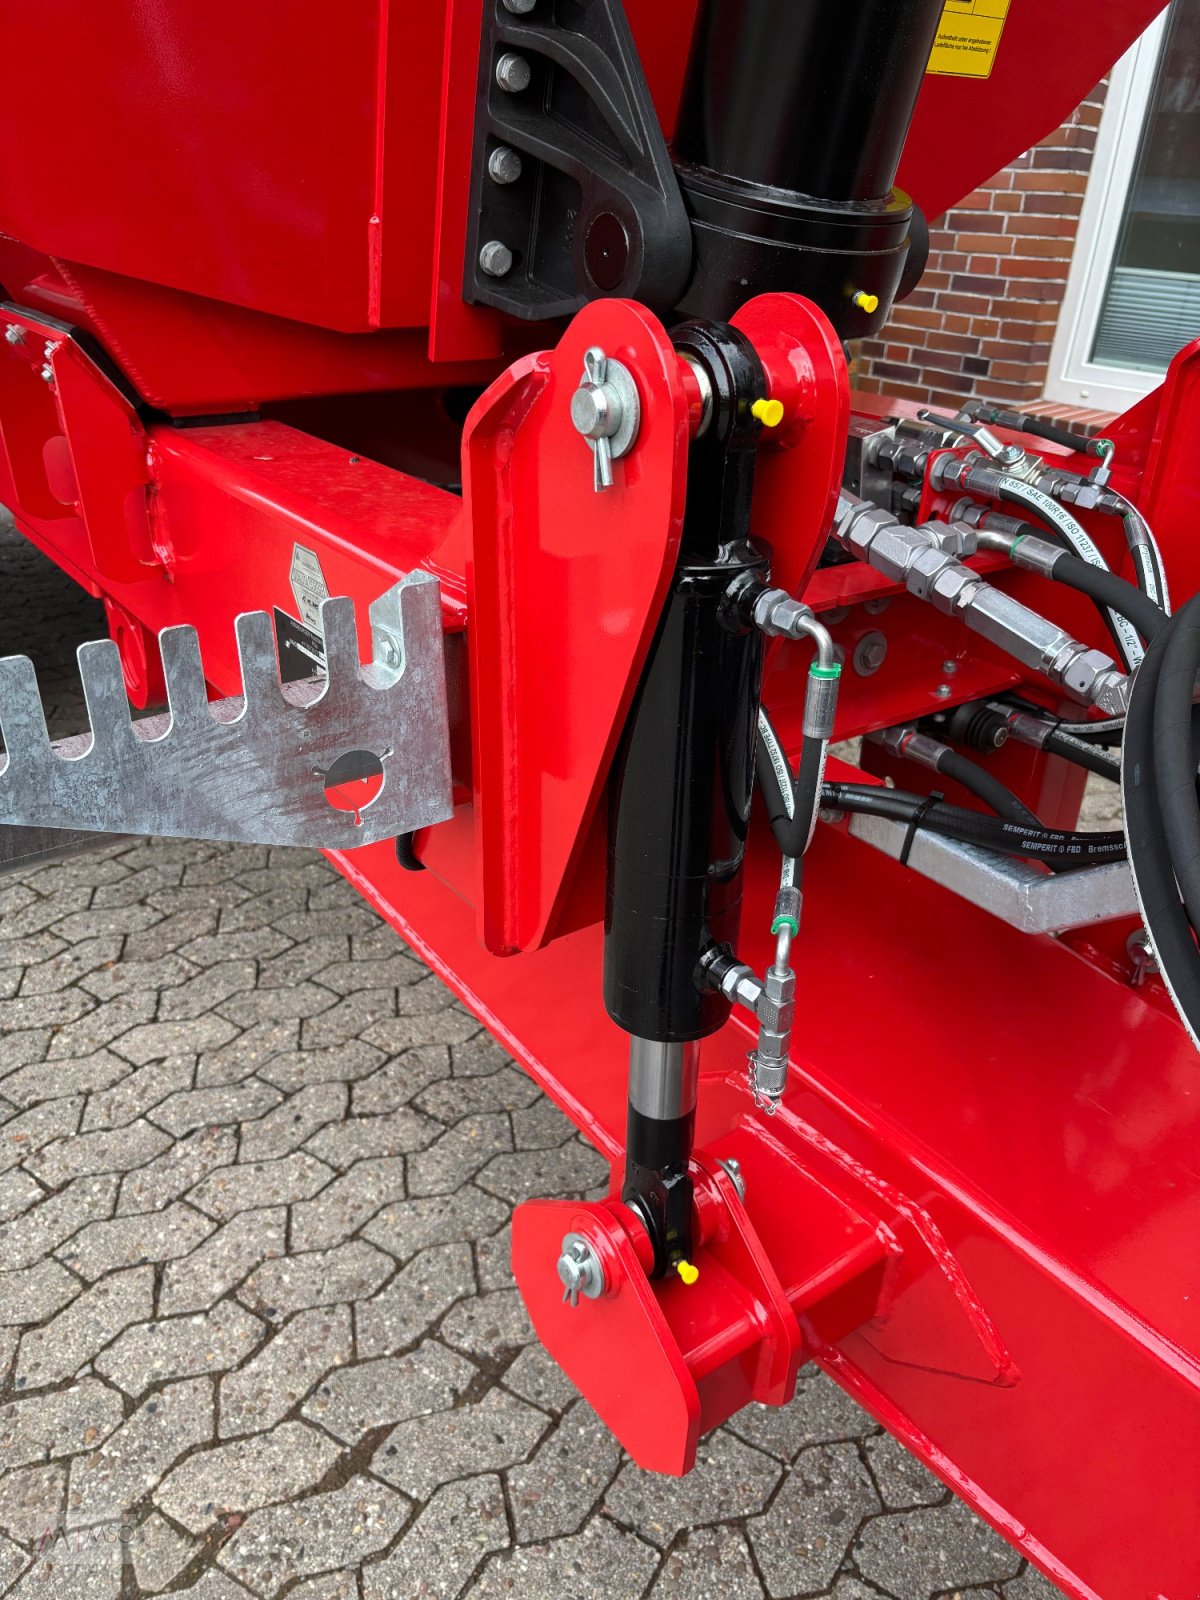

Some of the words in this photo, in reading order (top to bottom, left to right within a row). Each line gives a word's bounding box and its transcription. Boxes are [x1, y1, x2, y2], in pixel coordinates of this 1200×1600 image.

[1009, 481, 1023, 490] 857
[1026, 489, 1044, 501] SAE
[1042, 499, 1067, 520] 100R16
[1065, 520, 1080, 535] ISO
[1075, 534, 1094, 553] 11237
[760, 724, 768, 733] BC
[764, 733, 775, 750] TYPE
[776, 764, 784, 774] ISO
[1003, 824, 1041, 838] SEMPERIT
[1021, 841, 1058, 853] SEMPERIT
[1066, 845, 1081, 853] FBD
